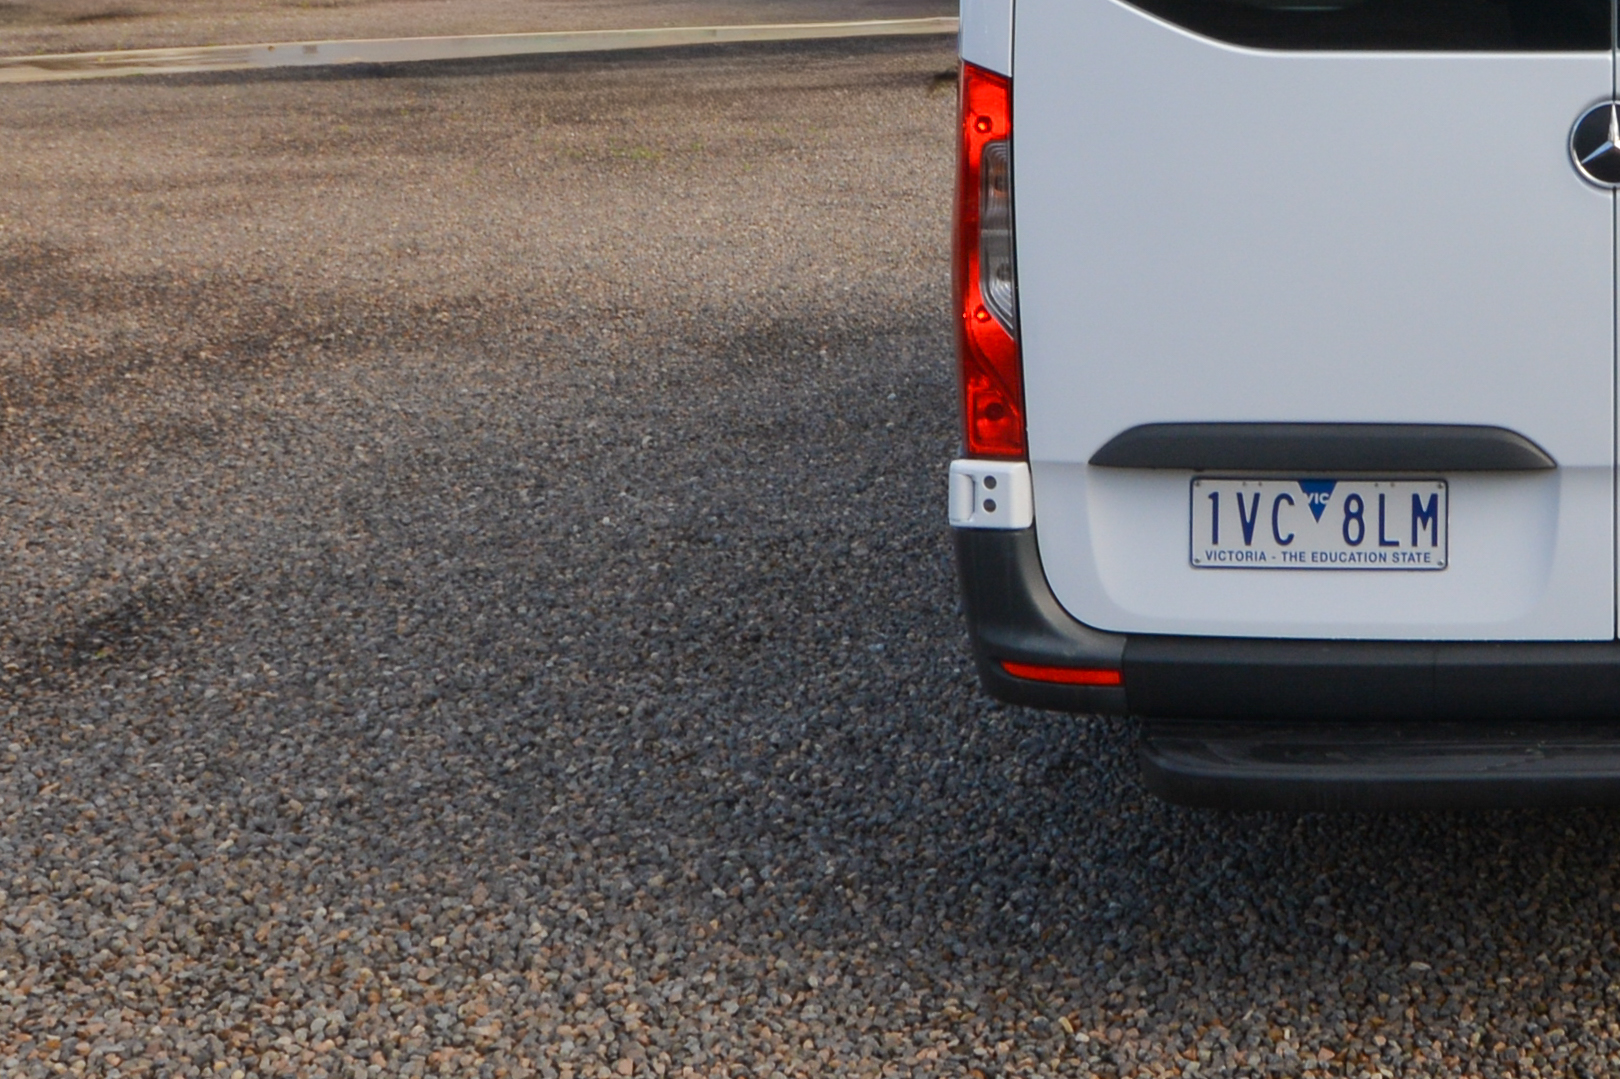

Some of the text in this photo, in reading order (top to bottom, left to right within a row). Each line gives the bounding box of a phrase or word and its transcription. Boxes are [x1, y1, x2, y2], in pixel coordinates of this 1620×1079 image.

[1207, 491, 1439, 547] 1VC 8LM
[1204, 549, 1268, 562] VICTORIA
[1281, 550, 1306, 563] THE
[1311, 550, 1387, 563] EDUCATION
[1391, 550, 1432, 563] STATE
